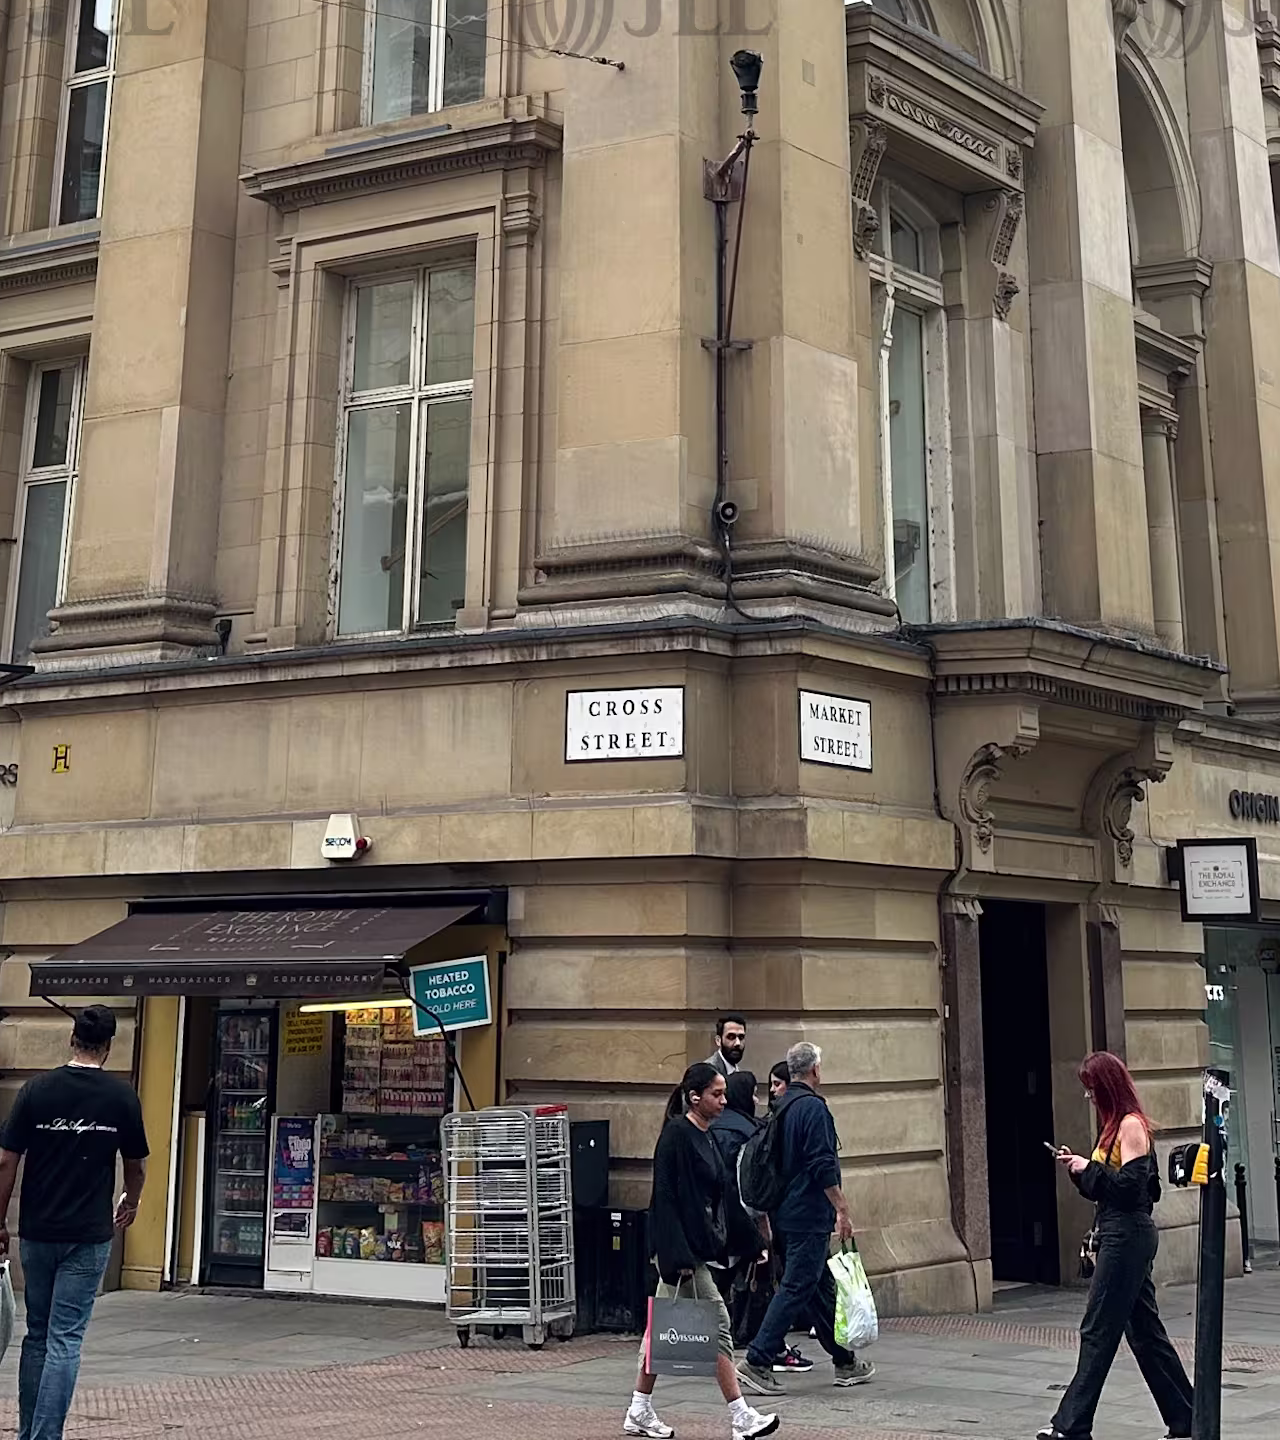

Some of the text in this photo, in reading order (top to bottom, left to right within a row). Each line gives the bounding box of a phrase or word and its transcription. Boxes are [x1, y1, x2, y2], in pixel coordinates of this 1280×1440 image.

[588, 699, 663, 716] CROSS
[809, 703, 862, 726] MARKET
[581, 731, 668, 750] STREET
[813, 735, 859, 759] STREET
[1228, 789, 1280, 822] ORIGIN
[204, 922, 341, 935] EXCHANGE
[38, 977, 109, 985] NEWSPAPERS
[273, 975, 376, 983] CONFECTIONERY
[428, 970, 469, 986] HEATED
[425, 983, 476, 1000] TOBACCO
[453, 998, 478, 1011] HERE
[659, 1327, 710, 1345] BRAVISSIMO
